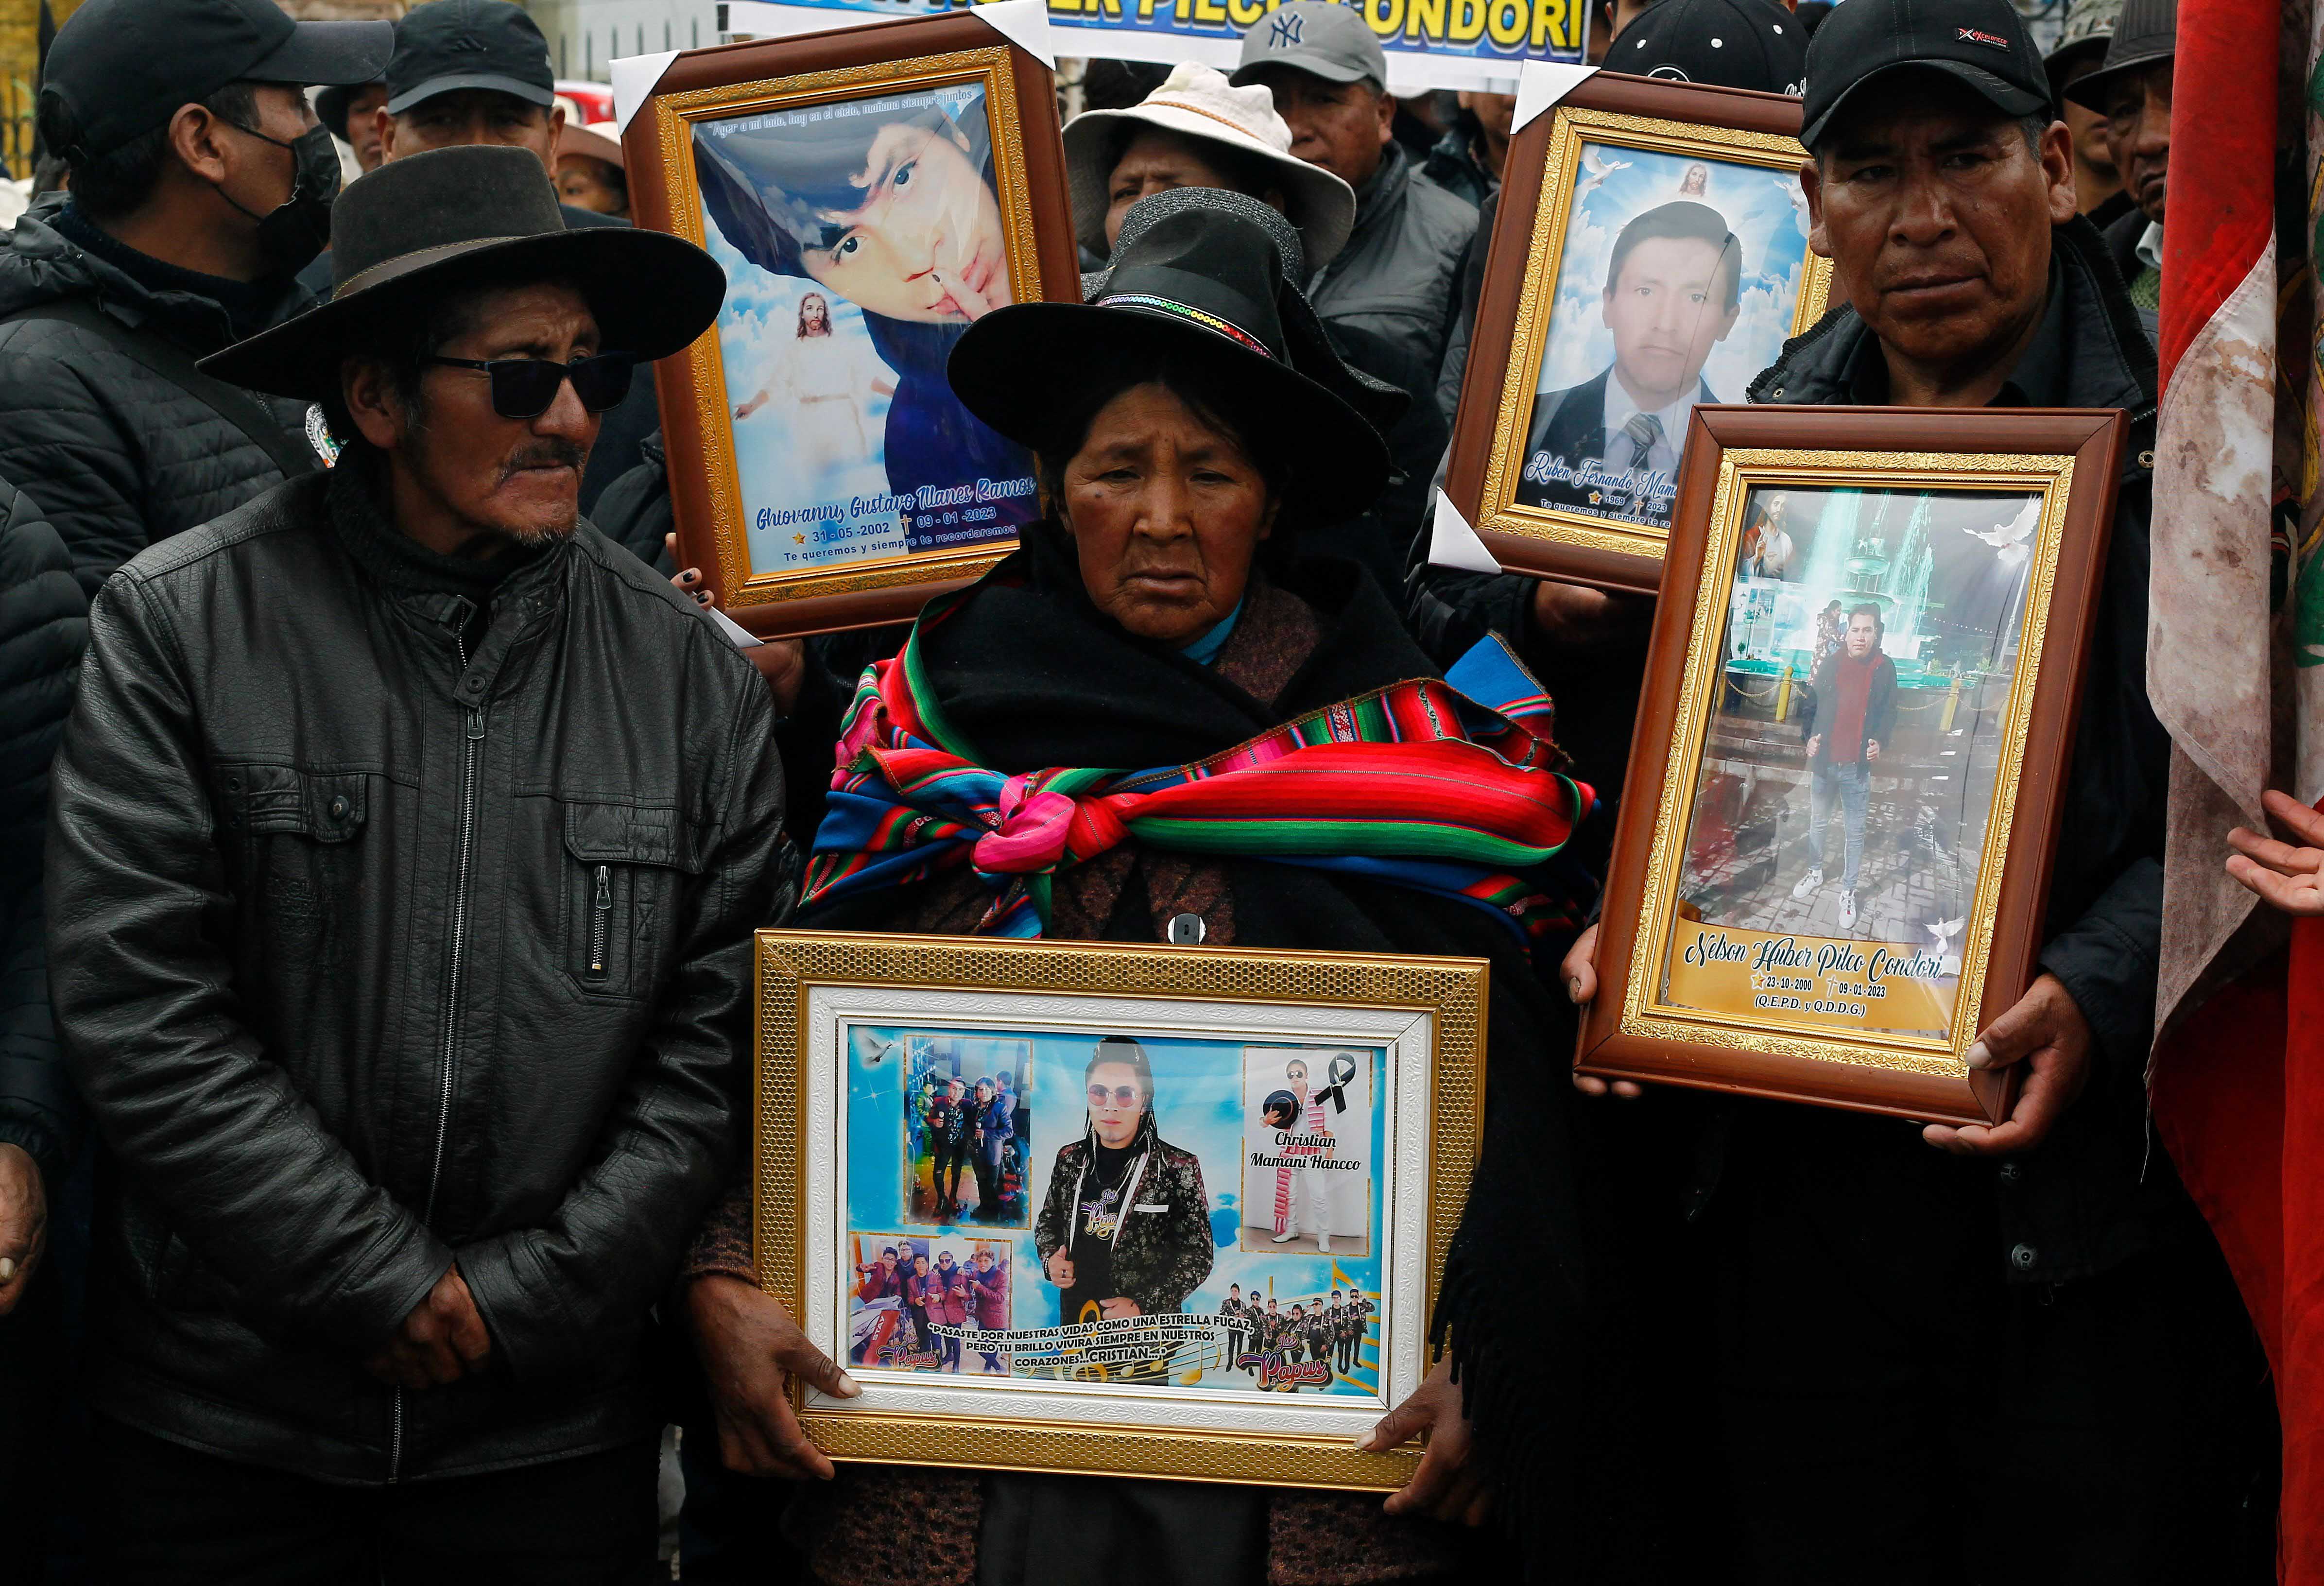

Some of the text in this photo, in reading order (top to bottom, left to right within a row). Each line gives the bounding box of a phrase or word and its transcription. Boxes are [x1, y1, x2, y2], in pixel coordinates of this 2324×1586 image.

[1353, 0, 1582, 50] ONDORI
[740, 122, 747, 132] a
[749, 119, 762, 131] mi
[763, 115, 786, 129] lado,
[788, 112, 807, 128] hoy
[809, 111, 822, 122] en
[824, 106, 832, 120] el
[834, 104, 861, 119] cielo,
[862, 100, 900, 115] mañana
[901, 94, 941, 111] siempre
[1526, 452, 1570, 484] Ruben
[1573, 459, 1633, 490] Fernando
[757, 476, 1037, 531] Ghiovanny Gustavo Illanes Ramos
[1540, 499, 1552, 509] Te
[1553, 501, 1599, 517] queremos
[1600, 510, 1606, 519] y
[1608, 511, 1646, 525] siempre
[1647, 518, 1658, 527] te
[1605, 495, 1668, 512] 1969 2023
[812, 530, 826, 542] 31
[838, 527, 853, 539] 05
[917, 515, 933, 528] 09
[943, 511, 959, 525] 01
[784, 525, 1016, 562] Te queremos y siempre te recordaremos
[1685, 931, 1944, 983] Nelson Huber Pilco Condori
[1804, 1001, 1812, 1012] y
[1274, 1131, 1337, 1148] Christian
[1251, 1152, 1361, 1171] Mamani Hancco
[966, 1329, 1215, 1352] PERO TU BRILLO VIVIRA SIEMPRE EN NUESTROS
[981, 1331, 1004, 1340] POR
[1007, 1328, 1059, 1340] NUESTRAS
[1062, 1324, 1093, 1335] VIDAS
[1096, 1320, 1128, 1331] COMO
[1133, 1315, 1158, 1327] UNA
[1160, 1314, 1210, 1326] ESTRELLA
[1214, 1315, 1255, 1333] FUGAZ,
[1236, 1350, 1333, 1392] Papus
